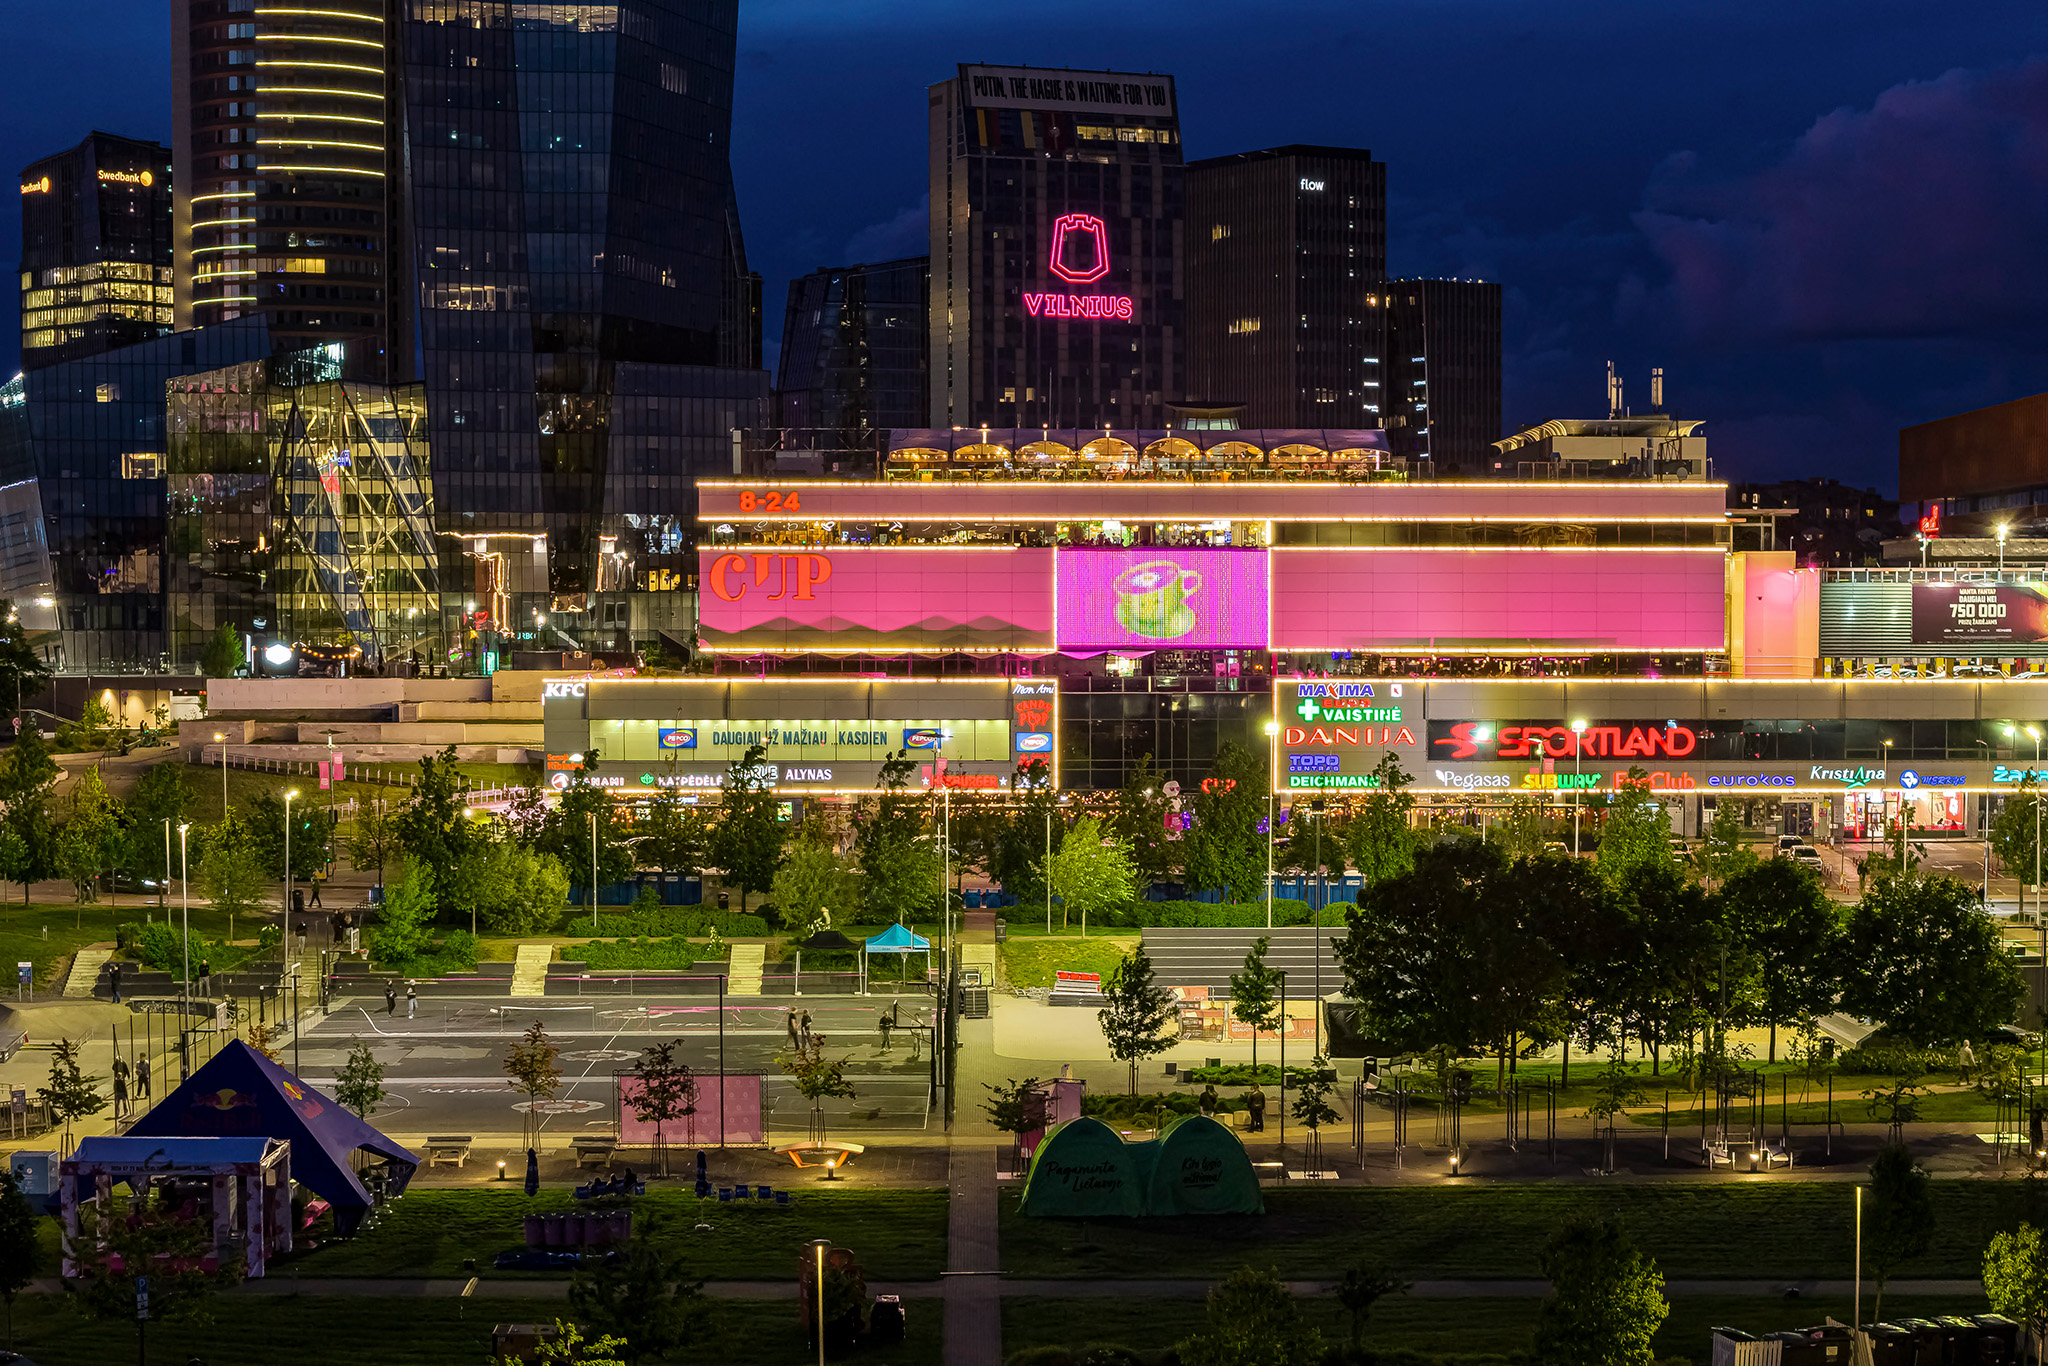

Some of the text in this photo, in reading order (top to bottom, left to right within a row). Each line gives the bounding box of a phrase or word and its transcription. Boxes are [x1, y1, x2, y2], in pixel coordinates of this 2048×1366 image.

[973, 75, 1166, 106] PUTIN, THE HAGUE IS WAITING FOR YOU
[98, 169, 141, 183] Swedbank
[1300, 179, 1325, 191] flow
[1024, 293, 1134, 319] VILNIUS
[739, 491, 801, 512] 8-24
[708, 553, 832, 602] CUP
[1959, 595, 1997, 603] DAUGIAU NEI
[1949, 603, 2007, 618] 750 000
[544, 683, 585, 698] KFC
[1012, 684, 1054, 695] Mon Ami
[1298, 683, 1375, 699] MAXIMA
[1015, 699, 1052, 713] CANDY
[1322, 705, 1402, 722] VAISTINĖ
[712, 731, 762, 746] DAUGIAU
[766, 728, 779, 746] UŽ
[783, 728, 828, 746] MAŽIAU
[1284, 726, 1416, 746] DANIJA
[1497, 727, 1696, 757] SPORTLAND
[1289, 754, 1340, 766] TOPO
[785, 768, 833, 781] ALYNAS
[1290, 776, 1380, 787] DEICHMANN
[1444, 771, 1511, 791] Pegasas
[1520, 773, 1602, 789] SUBWAY
[1708, 773, 1796, 787] eurokos
[1045, 1161, 1116, 1184] Pagaminta
[1072, 1176, 1123, 1193] Lietuvoje
